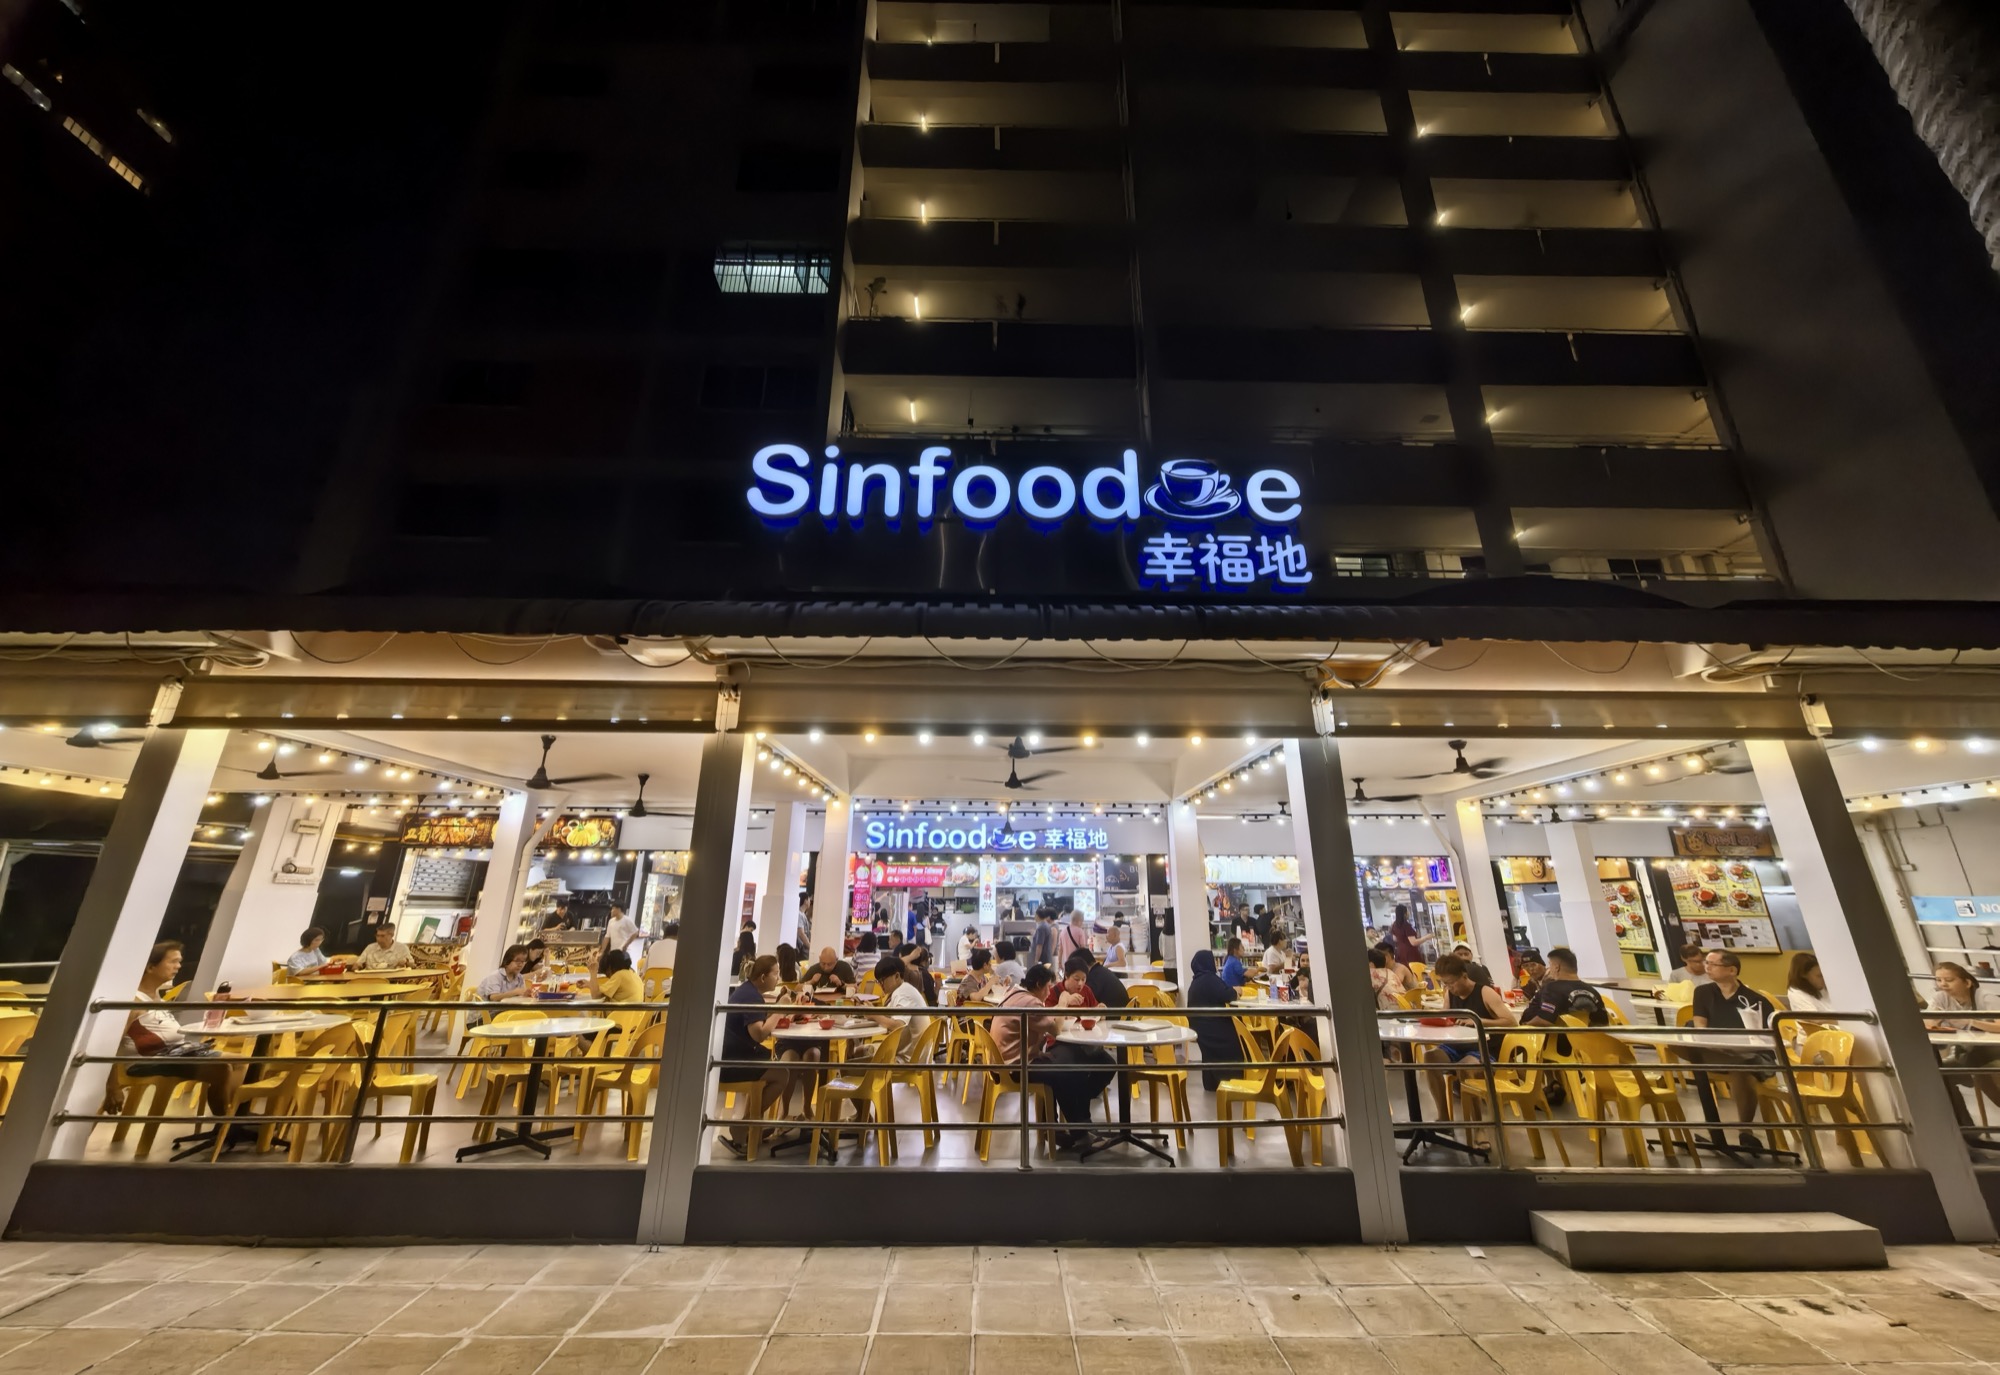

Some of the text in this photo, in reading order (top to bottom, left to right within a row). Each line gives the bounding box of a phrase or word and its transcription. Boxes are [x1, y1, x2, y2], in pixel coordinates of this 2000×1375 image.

[1143, 532, 1313, 584] 幸福地
[1045, 828, 1109, 850] 幸福地
